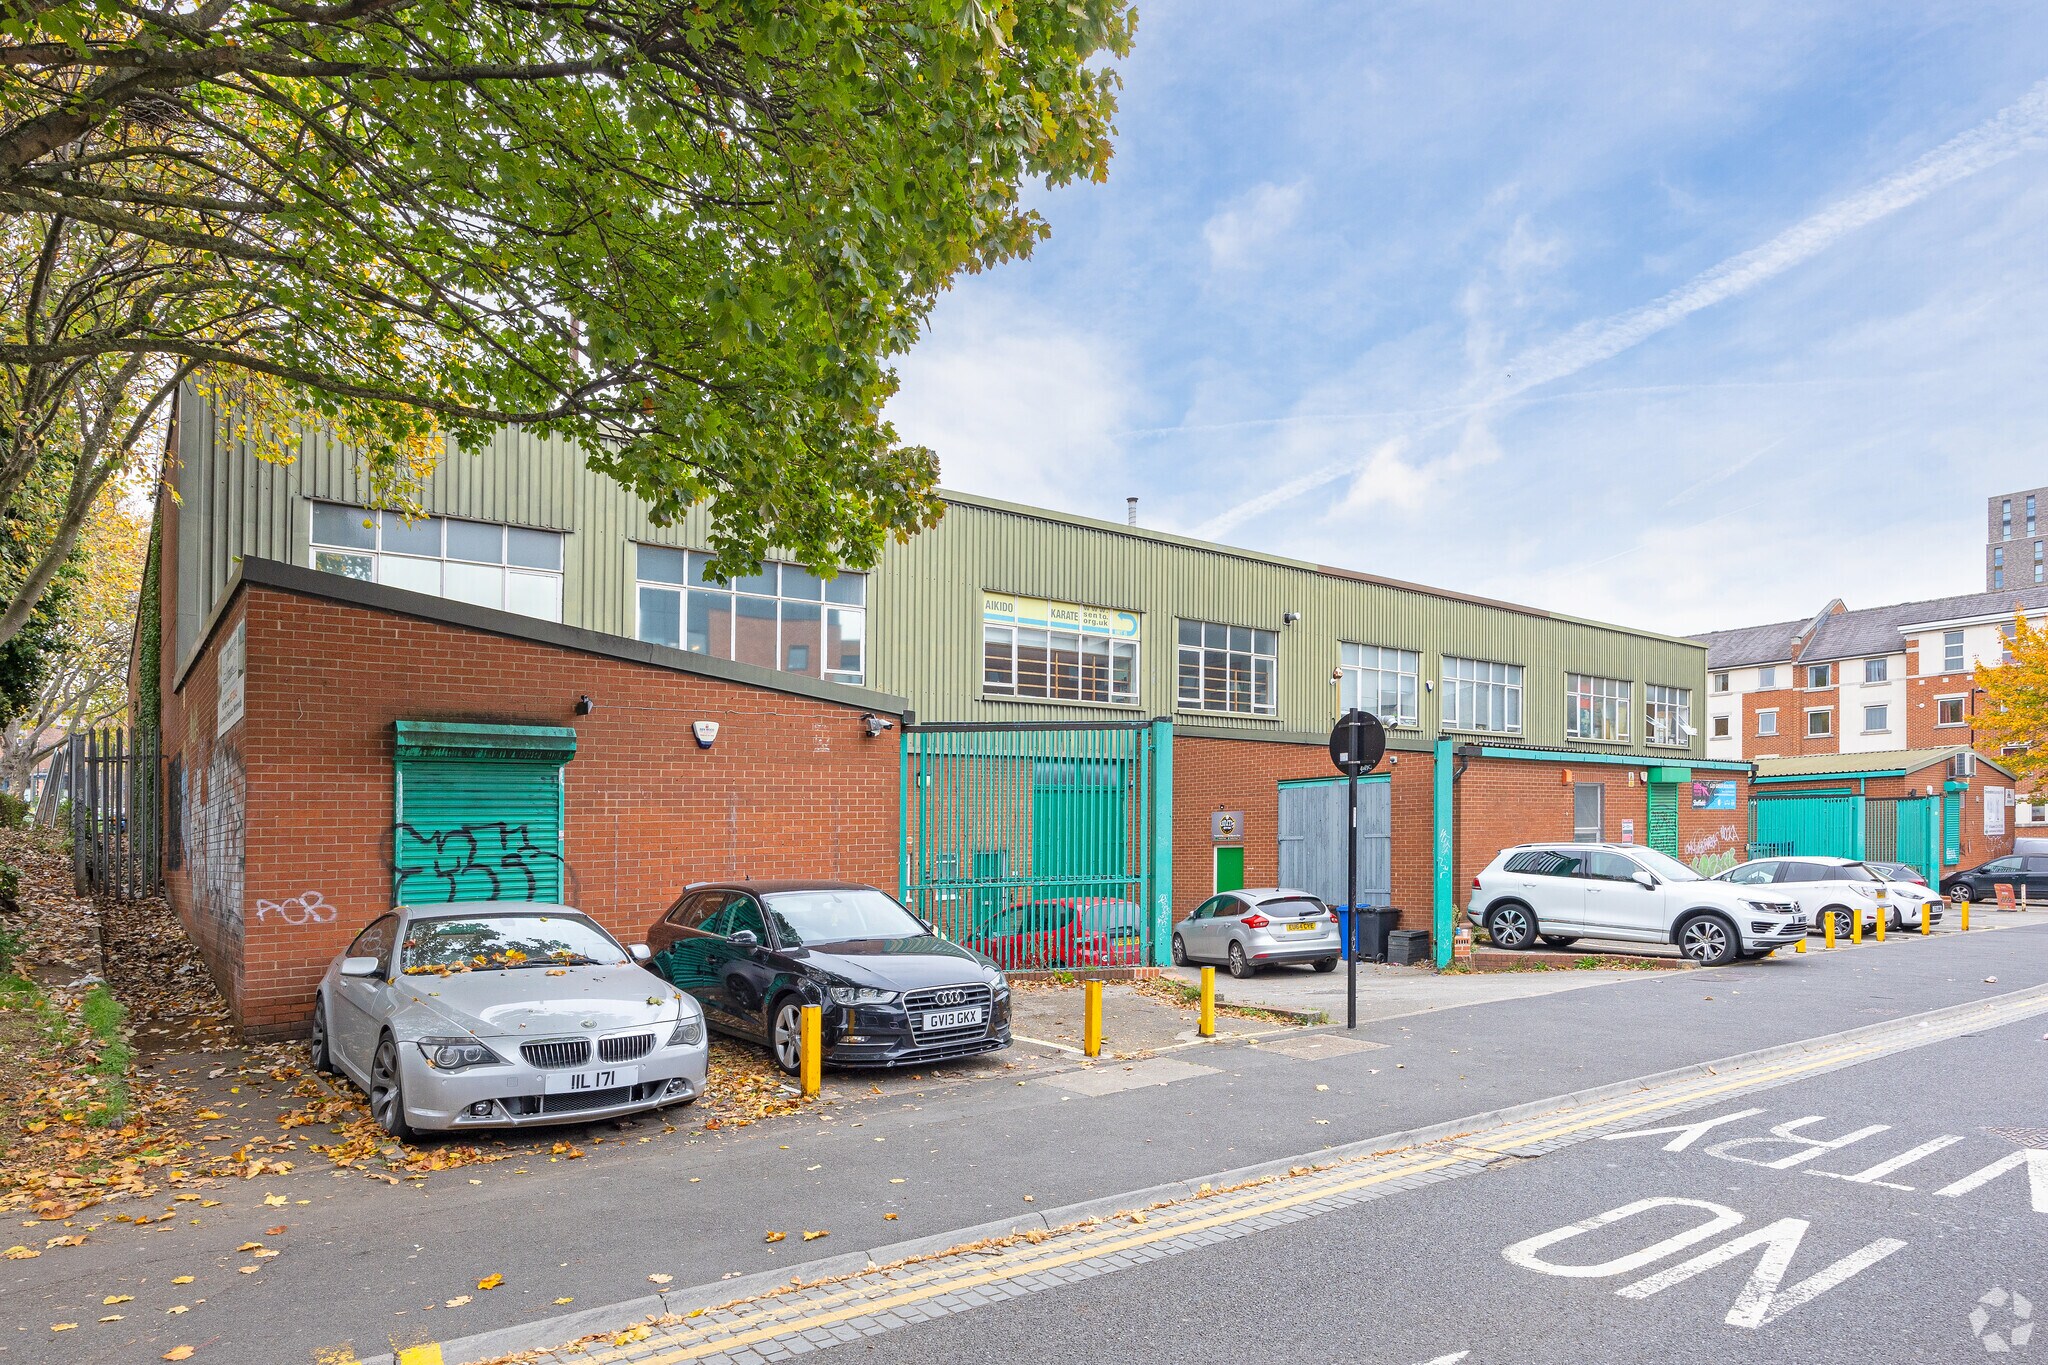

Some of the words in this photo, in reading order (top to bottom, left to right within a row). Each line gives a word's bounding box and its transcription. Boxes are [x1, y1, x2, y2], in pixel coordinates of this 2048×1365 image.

[985, 600, 1013, 613] AIKIDO
[1050, 608, 1079, 621] KARATE
[1083, 618, 1108, 626] org.uk
[931, 1014, 954, 1027] GV13
[957, 1010, 976, 1024] GKX
[1601, 1108, 2048, 1213] NTRY
[1501, 1197, 1908, 1329] NO
